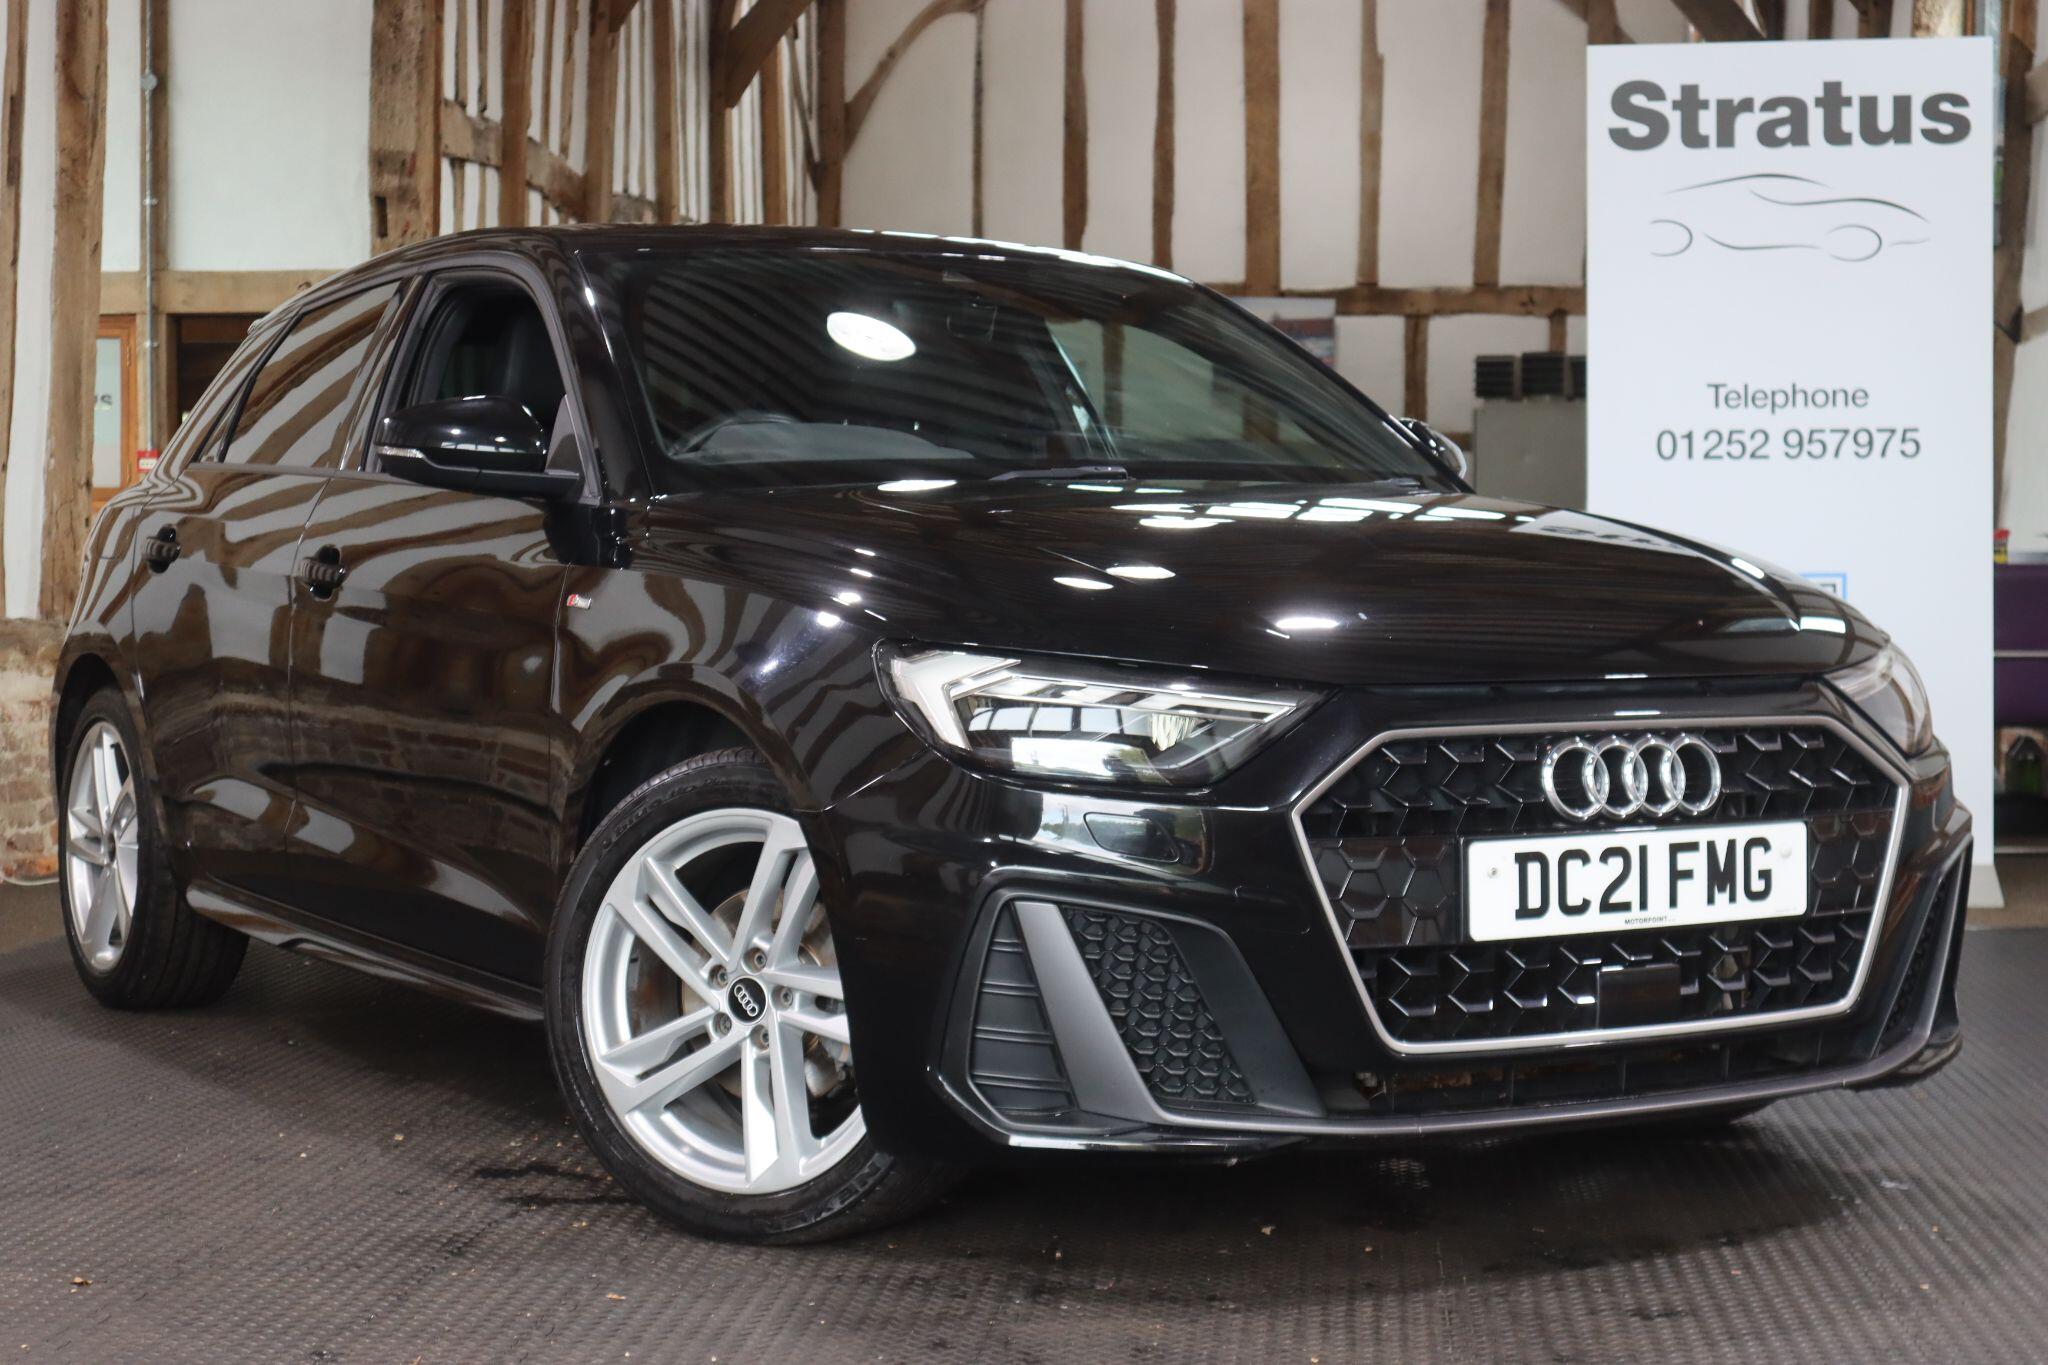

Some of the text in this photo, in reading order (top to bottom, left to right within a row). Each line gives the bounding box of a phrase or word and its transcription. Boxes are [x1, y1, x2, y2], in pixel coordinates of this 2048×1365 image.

[1608, 79, 1972, 152] Stratus
[1707, 382, 1869, 415] Telephone
[1656, 427, 1921, 461] 01252 957975
[1514, 836, 1773, 921] DC21 FMG
